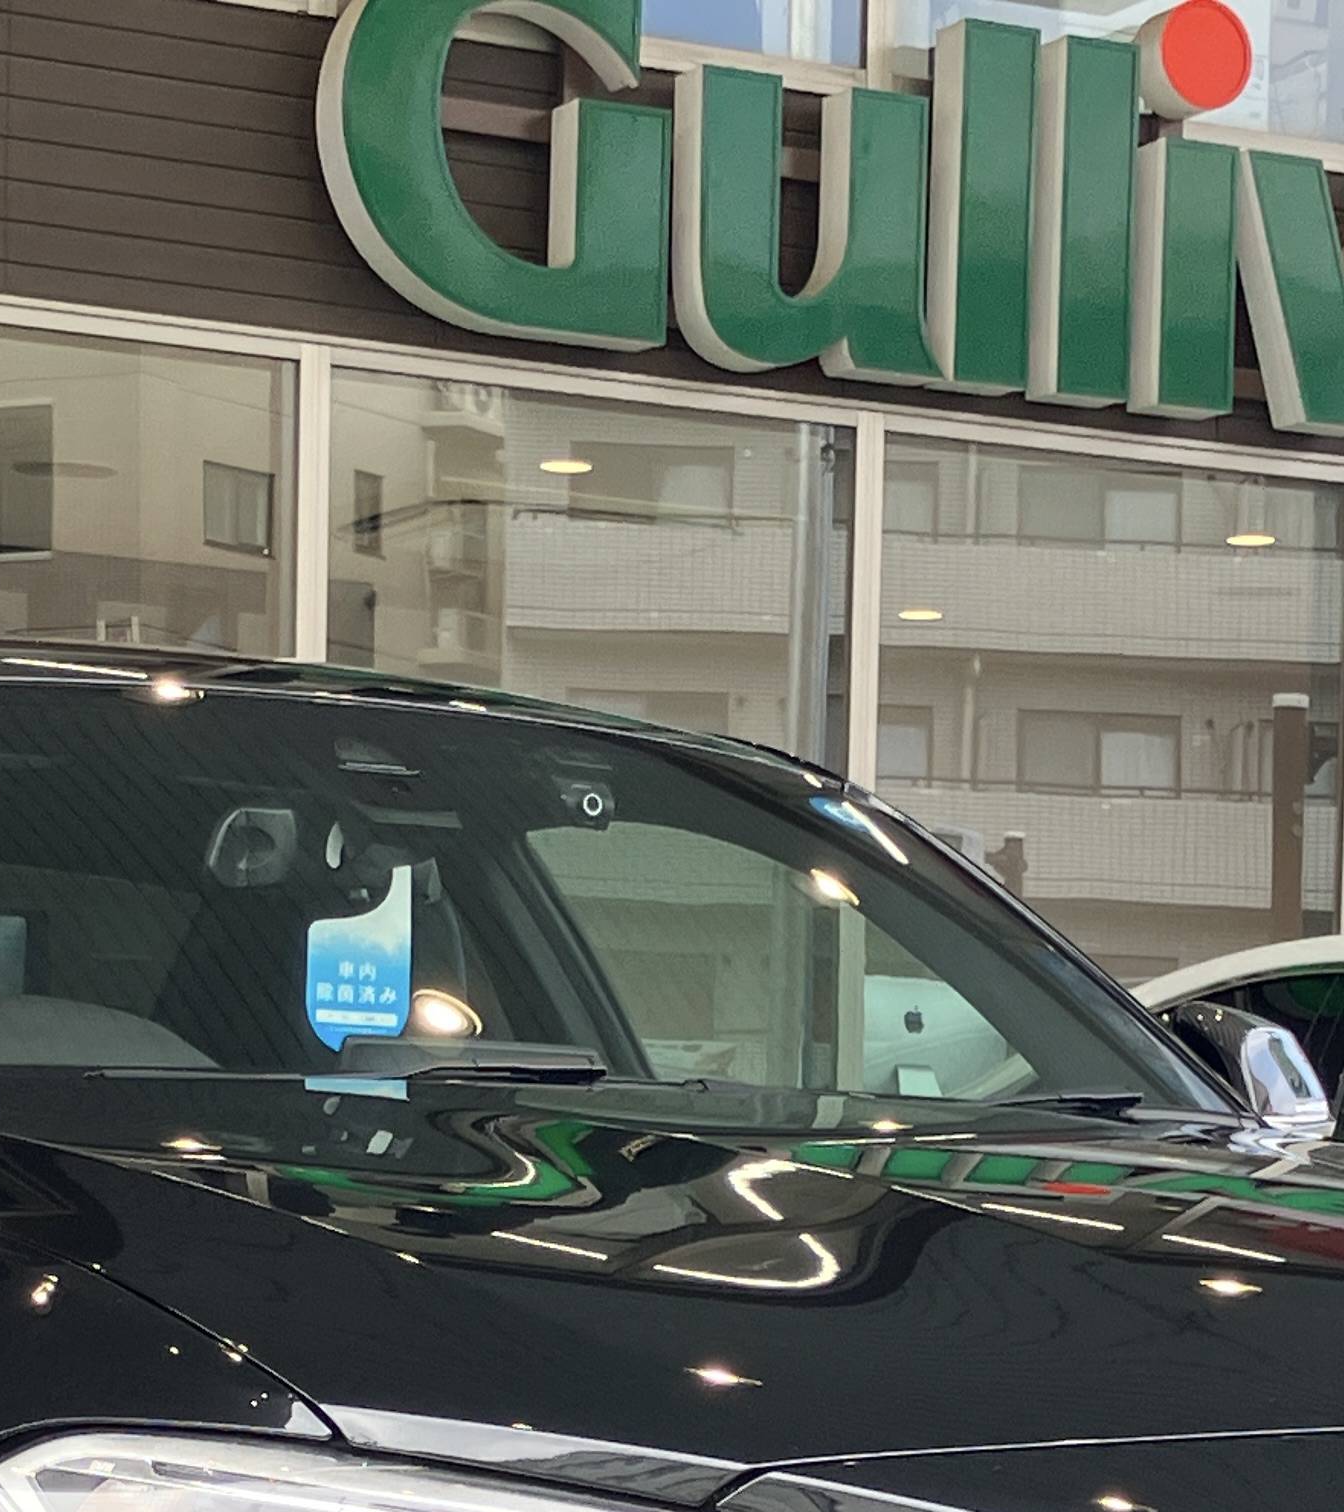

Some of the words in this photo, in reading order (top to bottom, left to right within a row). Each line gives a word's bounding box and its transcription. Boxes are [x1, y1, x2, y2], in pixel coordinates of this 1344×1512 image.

[338, 960, 376, 981] 車内
[316, 982, 397, 1005] 除菌済み
